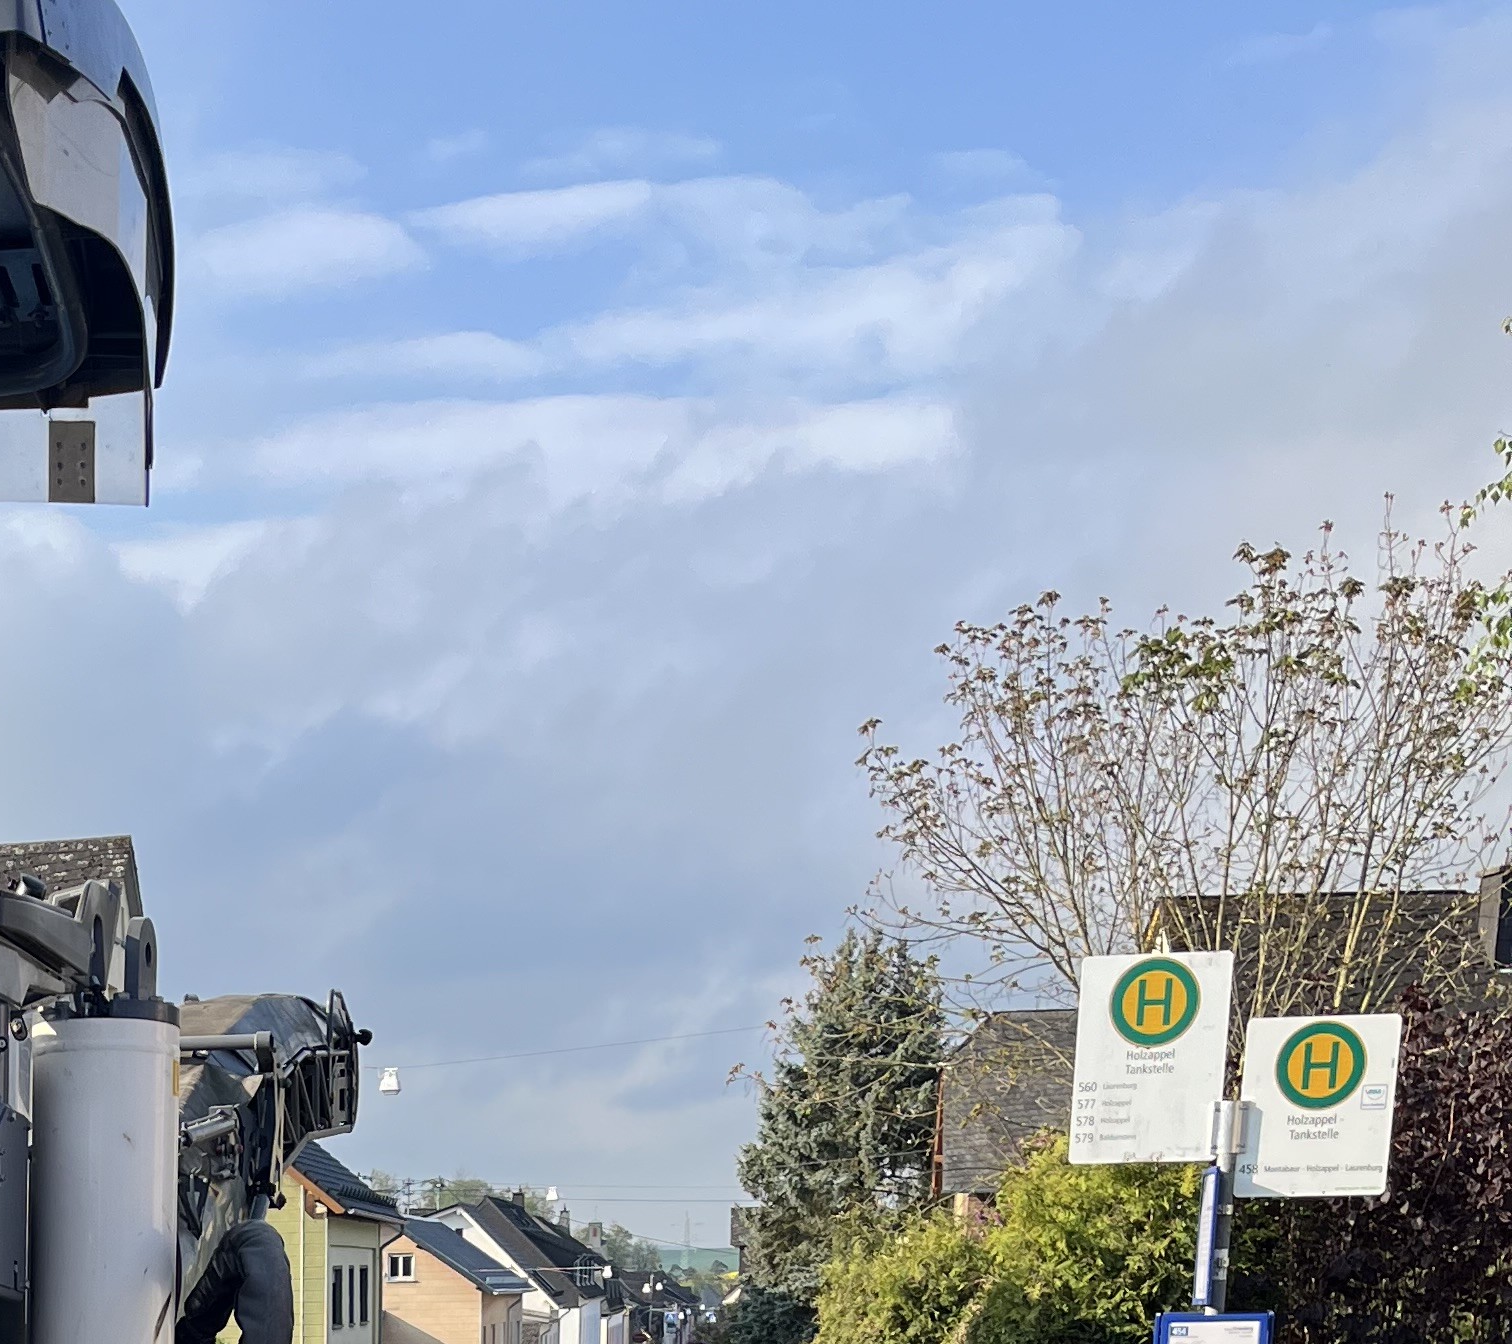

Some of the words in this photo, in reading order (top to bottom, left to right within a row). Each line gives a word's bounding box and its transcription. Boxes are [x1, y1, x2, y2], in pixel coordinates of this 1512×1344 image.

[1136, 978, 1173, 1027] H
[1126, 1048, 1176, 1062] Holzappel
[1125, 1063, 1175, 1075] Tankstelle
[1301, 1041, 1341, 1090] H
[1078, 1081, 1098, 1093] 560
[1077, 1098, 1097, 1110] 577
[1076, 1115, 1095, 1127] 578
[1287, 1114, 1338, 1127] Holzappel
[1074, 1132, 1094, 1144] 579
[1289, 1128, 1340, 1140] Tankstelle
[1238, 1164, 1259, 1175] 458
